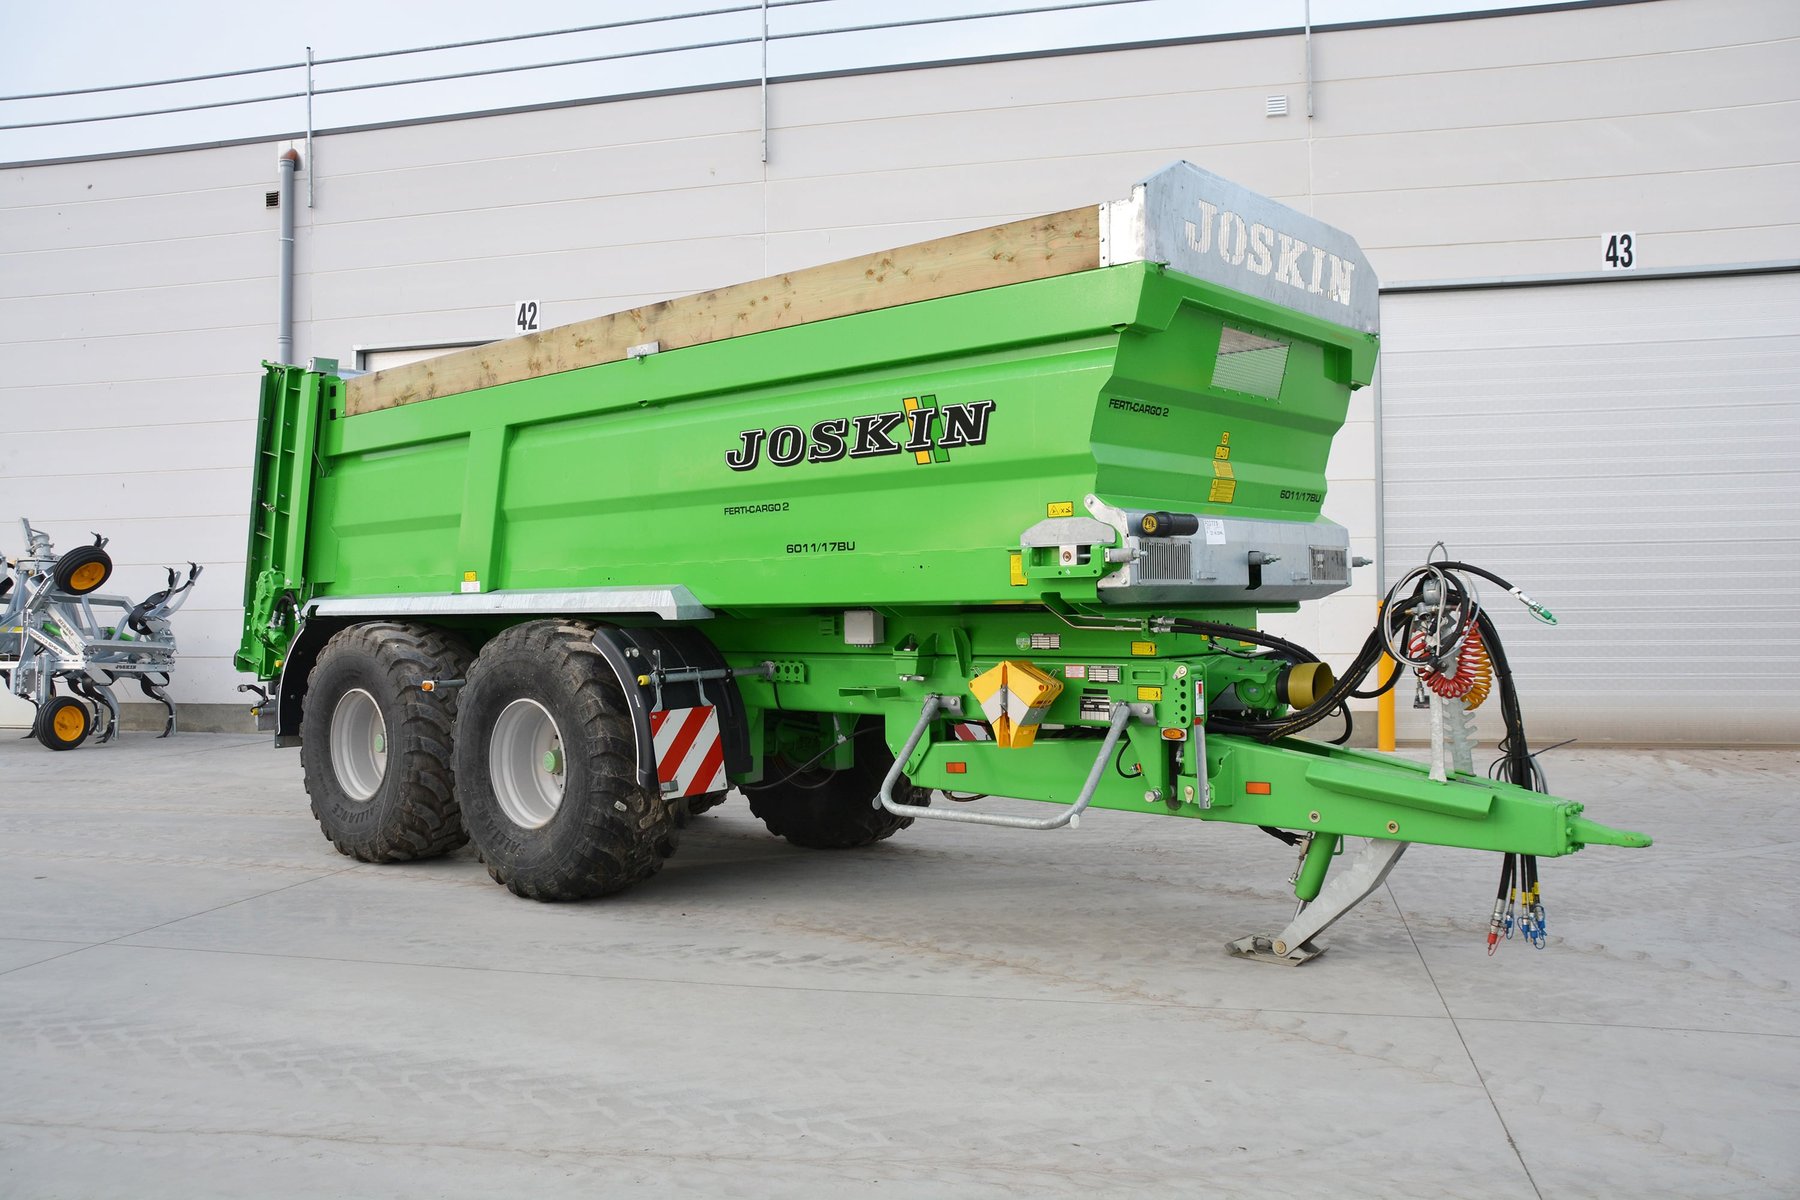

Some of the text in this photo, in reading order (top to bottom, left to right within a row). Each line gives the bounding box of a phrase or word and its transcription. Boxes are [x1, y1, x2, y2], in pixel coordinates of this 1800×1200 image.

[1184, 199, 1355, 306] JOSKIN
[1605, 234, 1633, 268] 43
[517, 301, 538, 331] 42
[1108, 398, 1170, 418] FERTI-CARGO 2
[725, 399, 997, 471] JOSKIN
[1280, 489, 1322, 503] 6011/17BU
[723, 502, 790, 516] FERTI-CARGO 2
[786, 541, 856, 554] 6011/17BU
